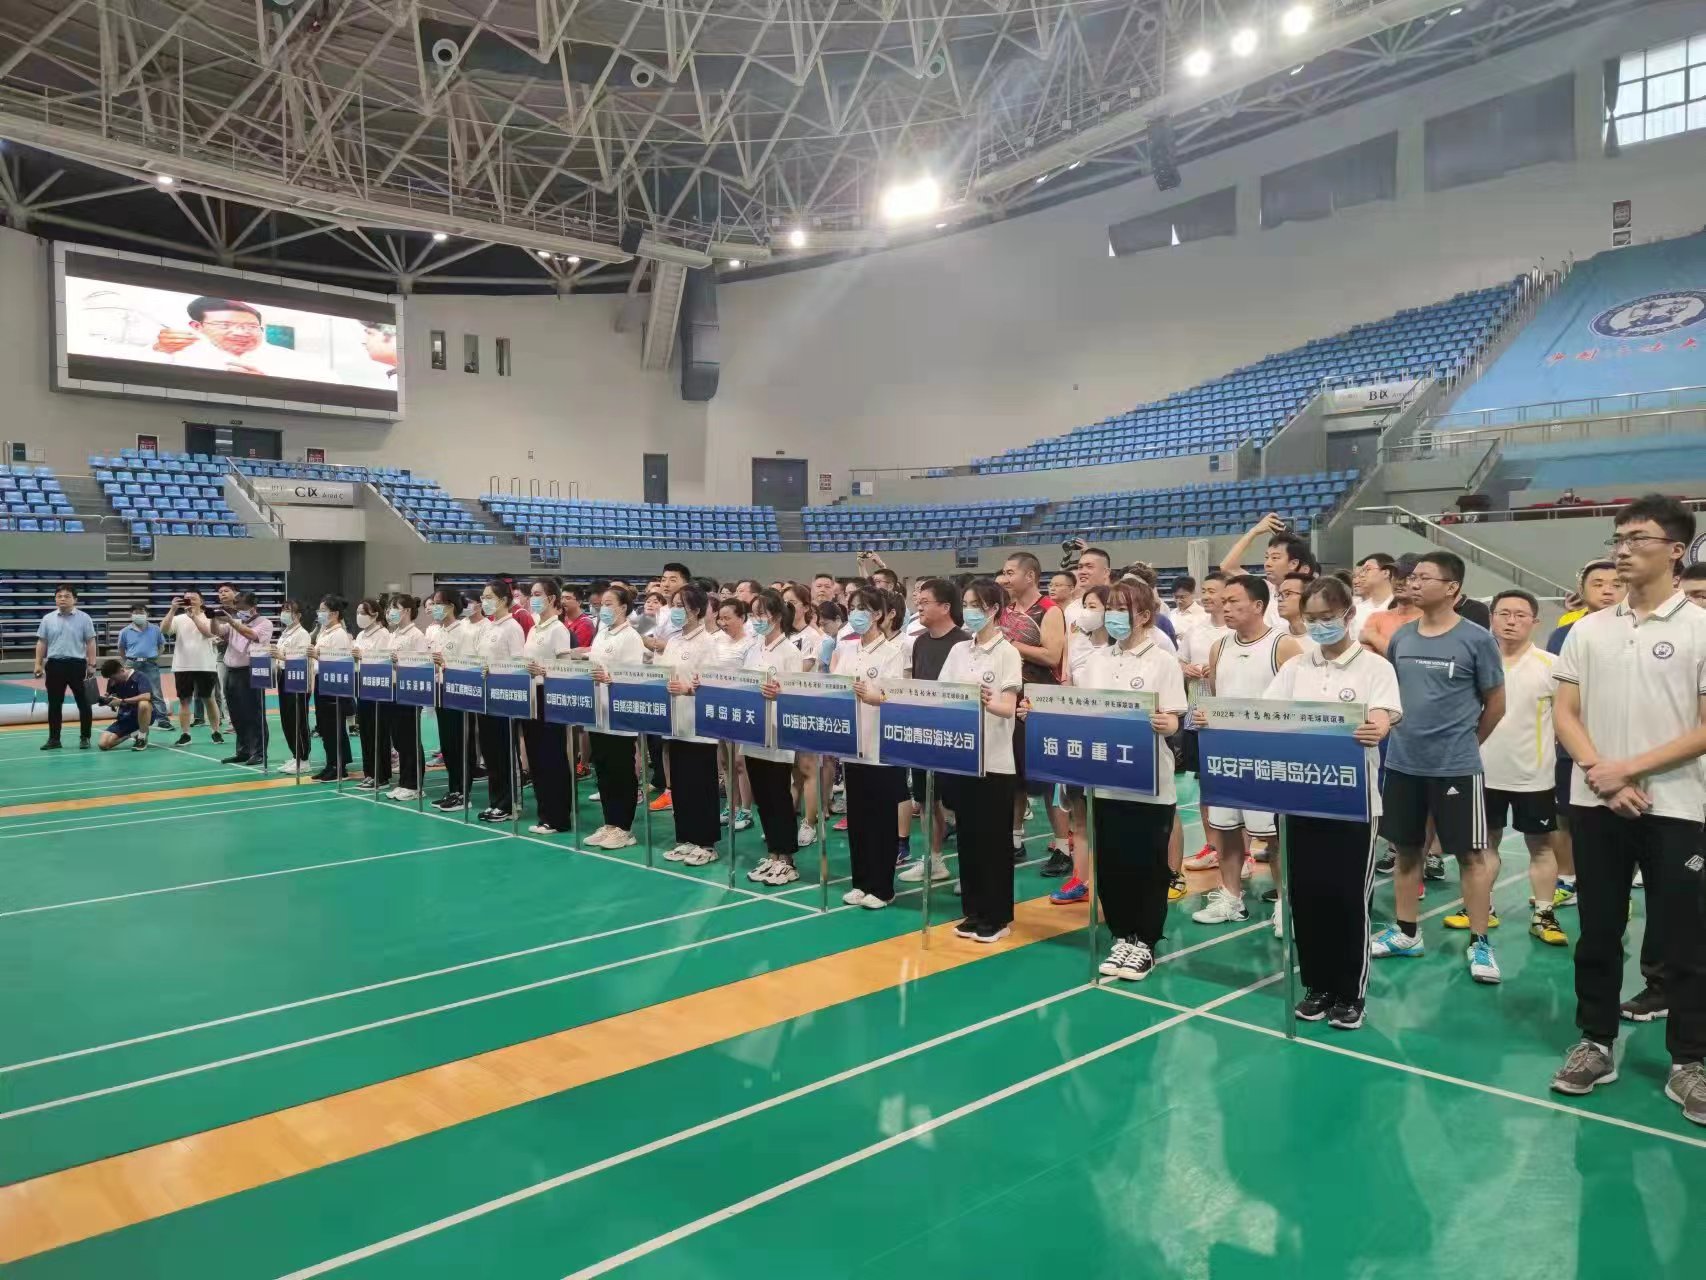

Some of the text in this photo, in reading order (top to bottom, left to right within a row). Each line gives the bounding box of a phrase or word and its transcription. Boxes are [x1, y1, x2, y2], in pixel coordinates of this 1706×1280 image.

[705, 704, 756, 725] 青岛海关
[782, 713, 851, 734] 中海油天津分公司
[884, 724, 975, 750] 中石油青岛海洋公司
[1043, 736, 1134, 764] 海西重工
[1207, 755, 1357, 788] 平安产险青岛分公司
